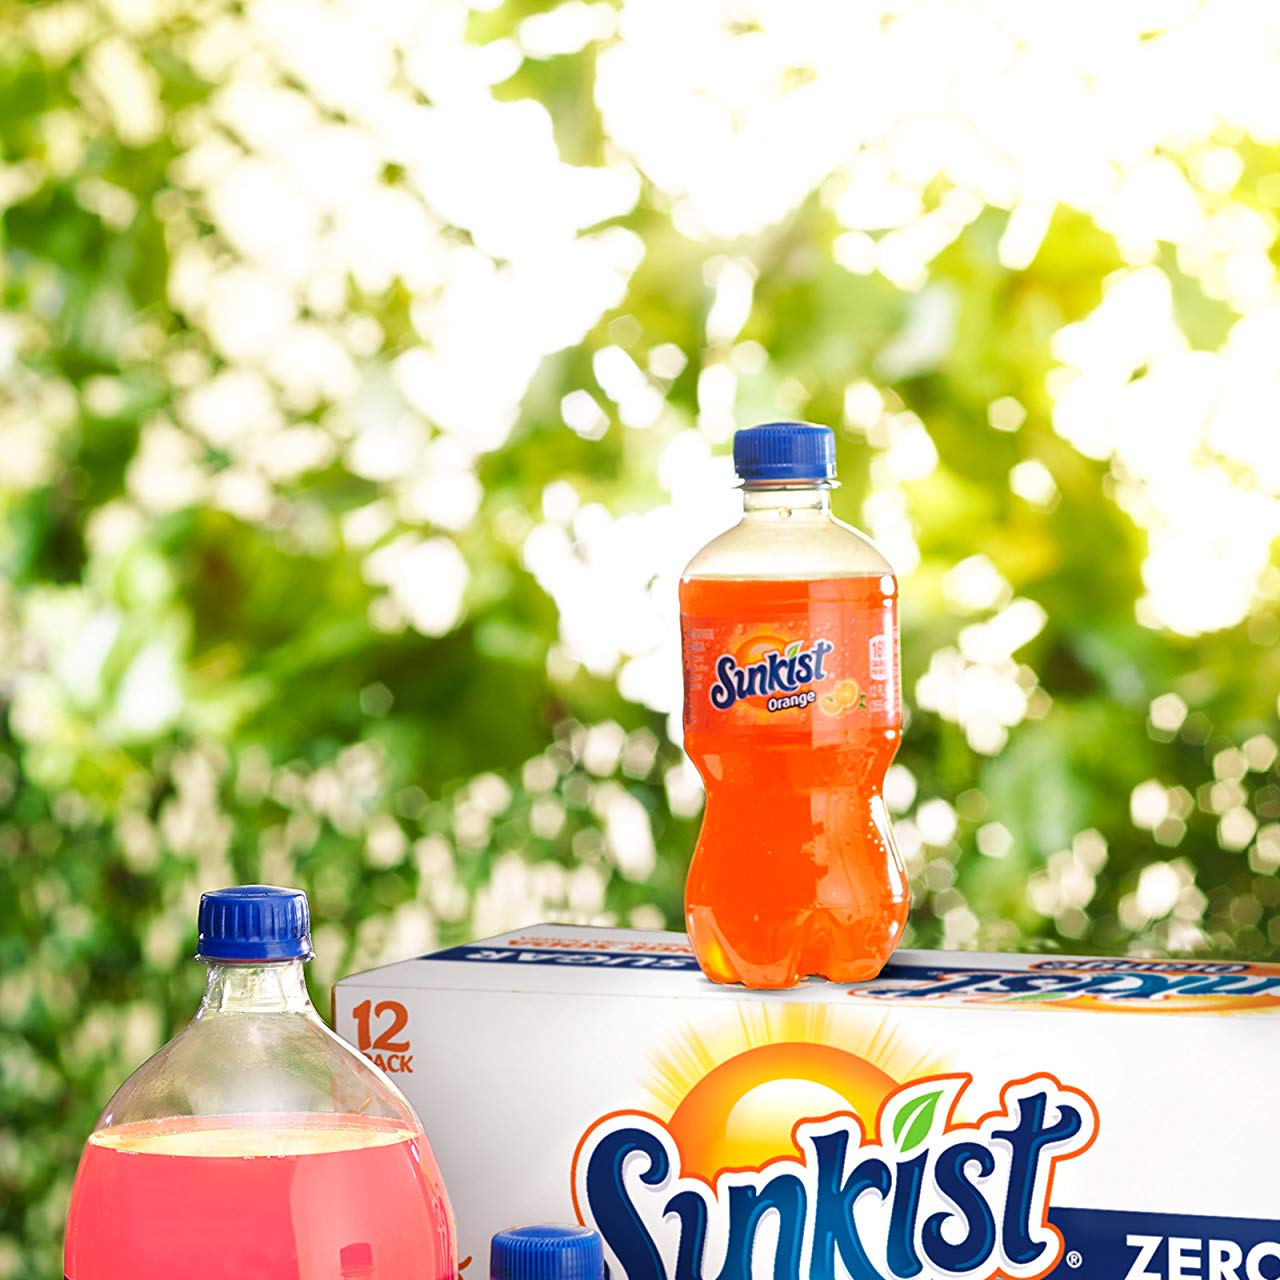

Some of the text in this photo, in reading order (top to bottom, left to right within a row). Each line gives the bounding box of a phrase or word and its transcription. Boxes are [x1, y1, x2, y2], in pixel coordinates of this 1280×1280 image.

[711, 641, 832, 709] Sunkist
[768, 691, 816, 712] Orange
[352, 1000, 411, 1053] 12
